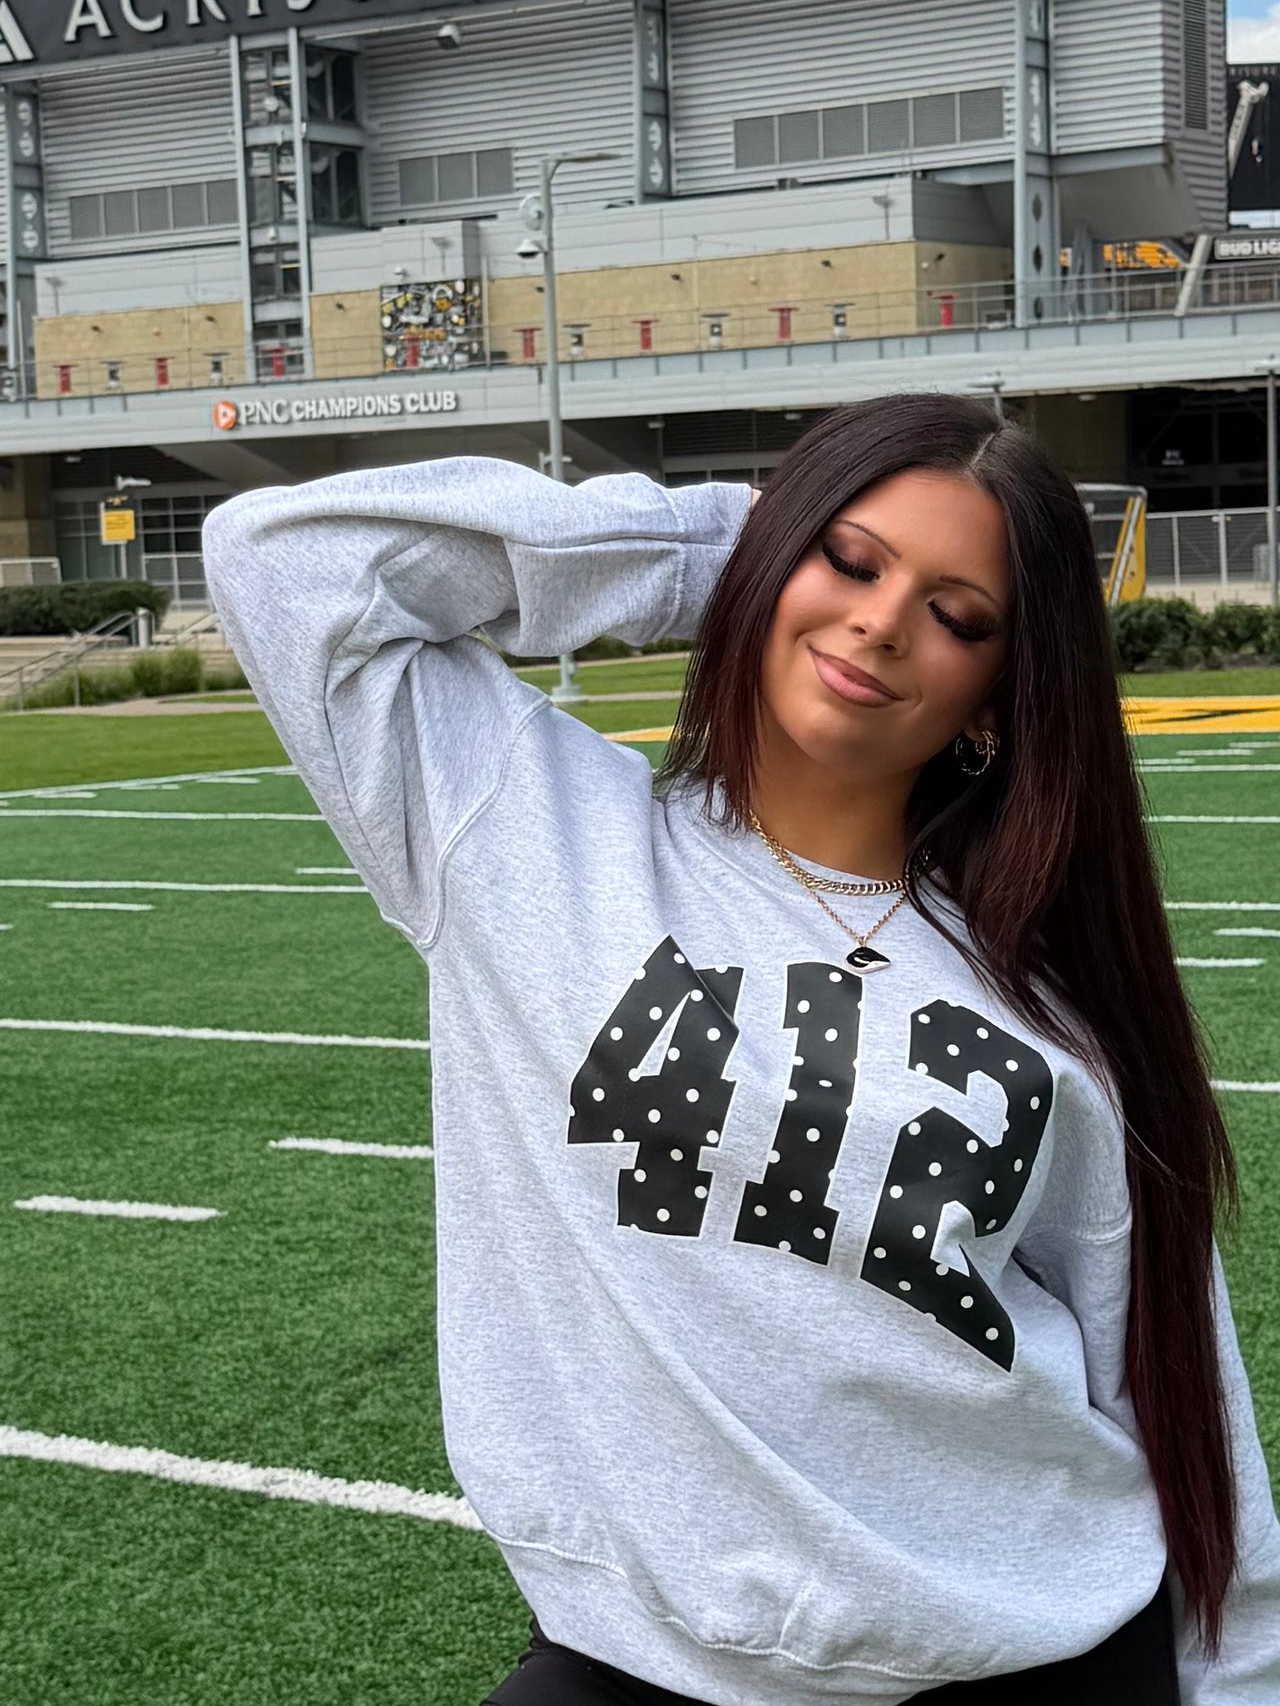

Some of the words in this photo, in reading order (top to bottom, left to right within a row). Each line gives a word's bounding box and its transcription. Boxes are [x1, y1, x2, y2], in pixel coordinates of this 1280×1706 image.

[239, 398, 290, 425] PNC
[290, 394, 402, 421] CHAMPIONS
[404, 390, 458, 413] CLUB
[567, 934, 1055, 1374] 412
